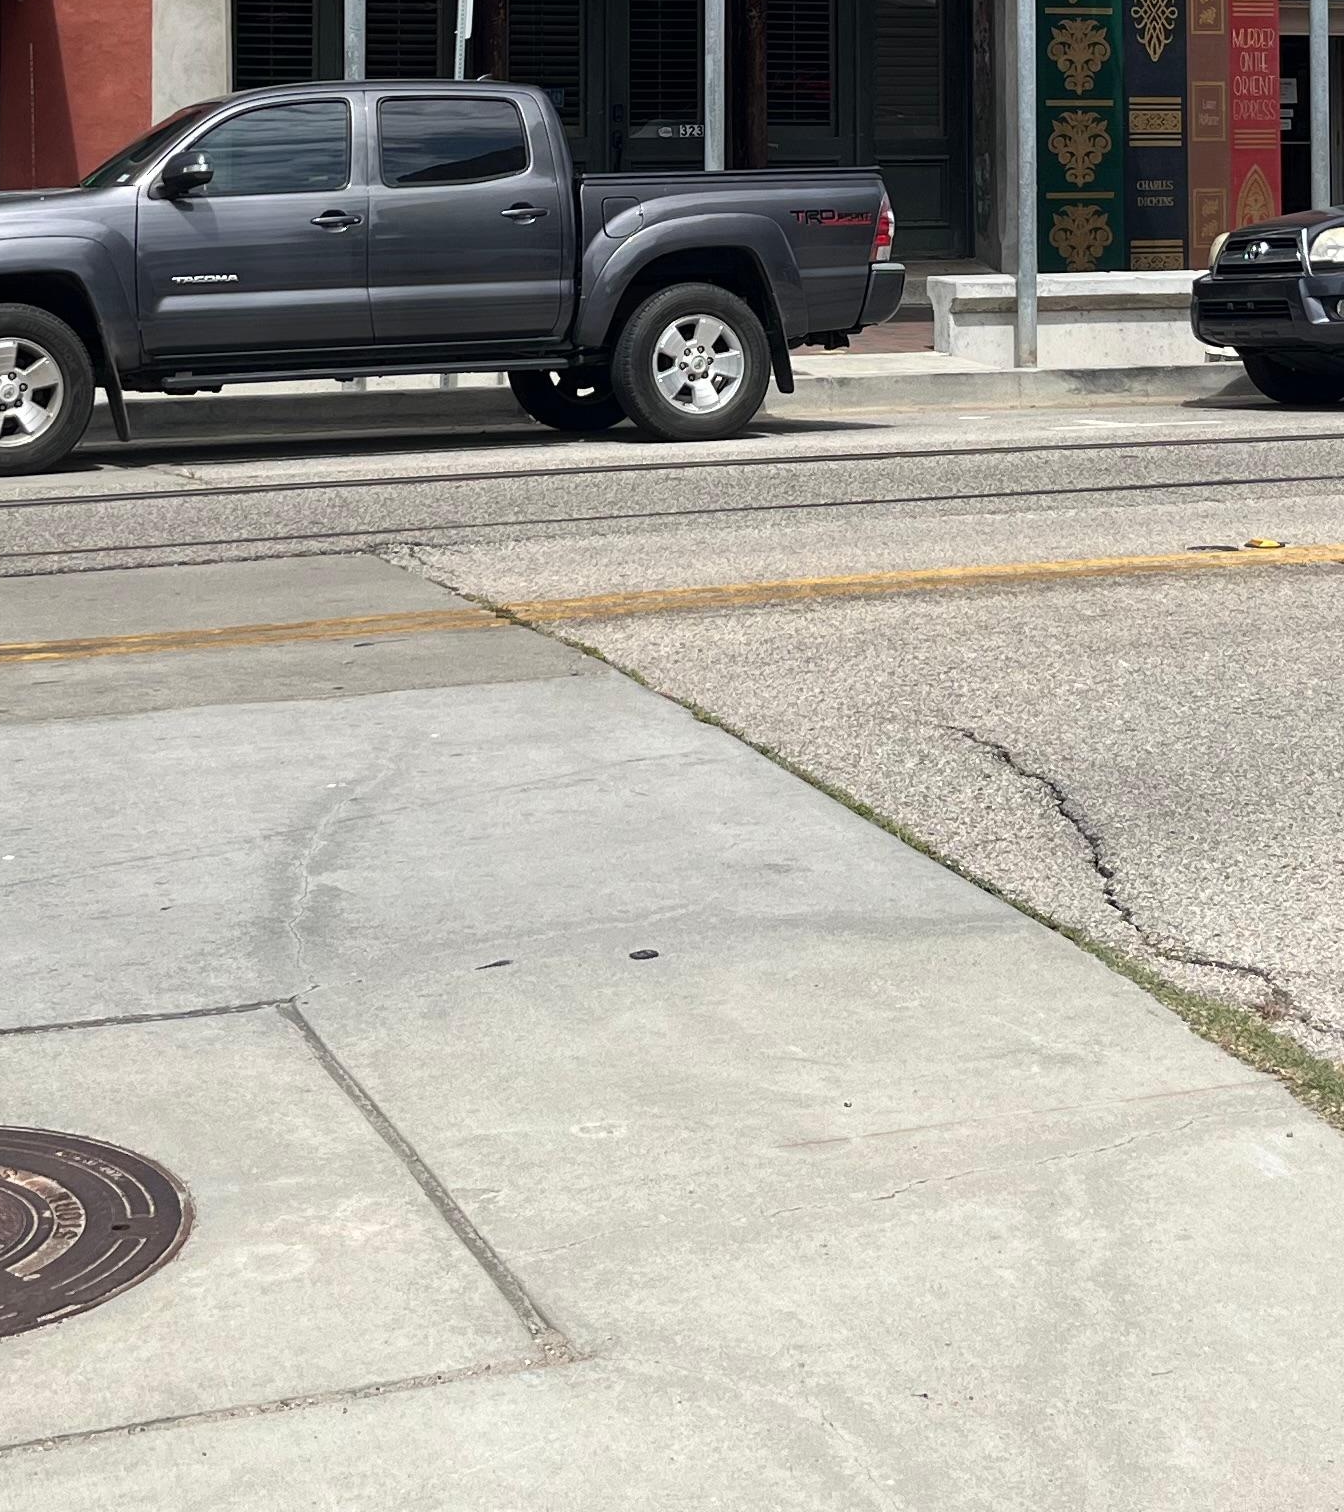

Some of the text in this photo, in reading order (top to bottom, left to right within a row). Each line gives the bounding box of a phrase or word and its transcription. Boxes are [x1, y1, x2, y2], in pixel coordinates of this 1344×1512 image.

[1232, 28, 1275, 48] MURDER
[1239, 51, 1269, 73] ON THE
[1233, 74, 1275, 98] ORIENT
[1232, 98, 1277, 122] EXPRESS
[680, 125, 704, 137] 323
[1136, 180, 1175, 191] CHARLES
[1136, 196, 1175, 207] DICKENS
[789, 210, 836, 225] TRD
[171, 273, 239, 285] TACOMA
